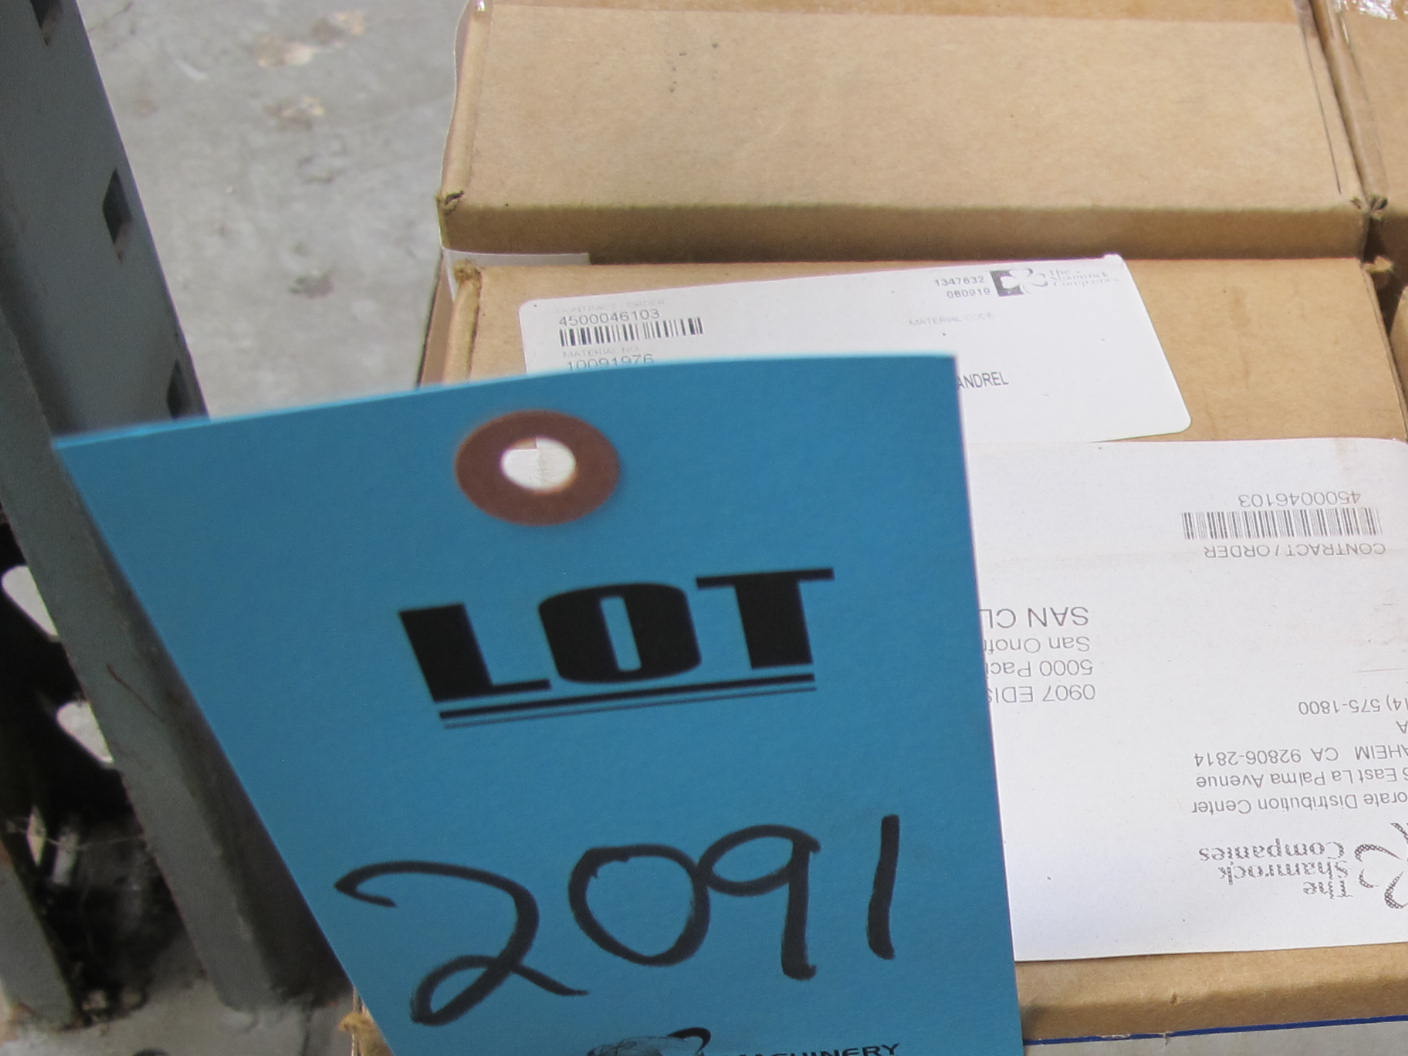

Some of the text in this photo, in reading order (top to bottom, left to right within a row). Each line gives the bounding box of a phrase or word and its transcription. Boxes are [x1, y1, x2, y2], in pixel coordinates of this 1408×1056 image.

[559, 309, 660, 327] 4500046103
[1238, 490, 1361, 507] 4500046103
[1204, 544, 1270, 558] ORDER
[1286, 542, 1386, 556] CONTRACT
[1027, 606, 1089, 628] SAN
[397, 567, 835, 703] LOT
[1048, 635, 1090, 652] San
[1039, 659, 1093, 677] 5000
[1042, 684, 1096, 702] 0907
[1298, 698, 1381, 715] 575-1800
[1194, 748, 1301, 767] 92806-2814
[1310, 747, 1338, 761] CA
[1195, 773, 1264, 788] Avenue
[1270, 770, 1326, 786] Palma
[1332, 769, 1353, 784] La
[1358, 766, 1397, 783] East
[1192, 798, 1251, 815] Center
[1258, 792, 1358, 810] Distribution
[1199, 837, 1344, 861] Companies
[1217, 860, 1349, 886] Shamrock
[1303, 879, 1353, 899] The
[334, 814, 899, 1026] 2091
